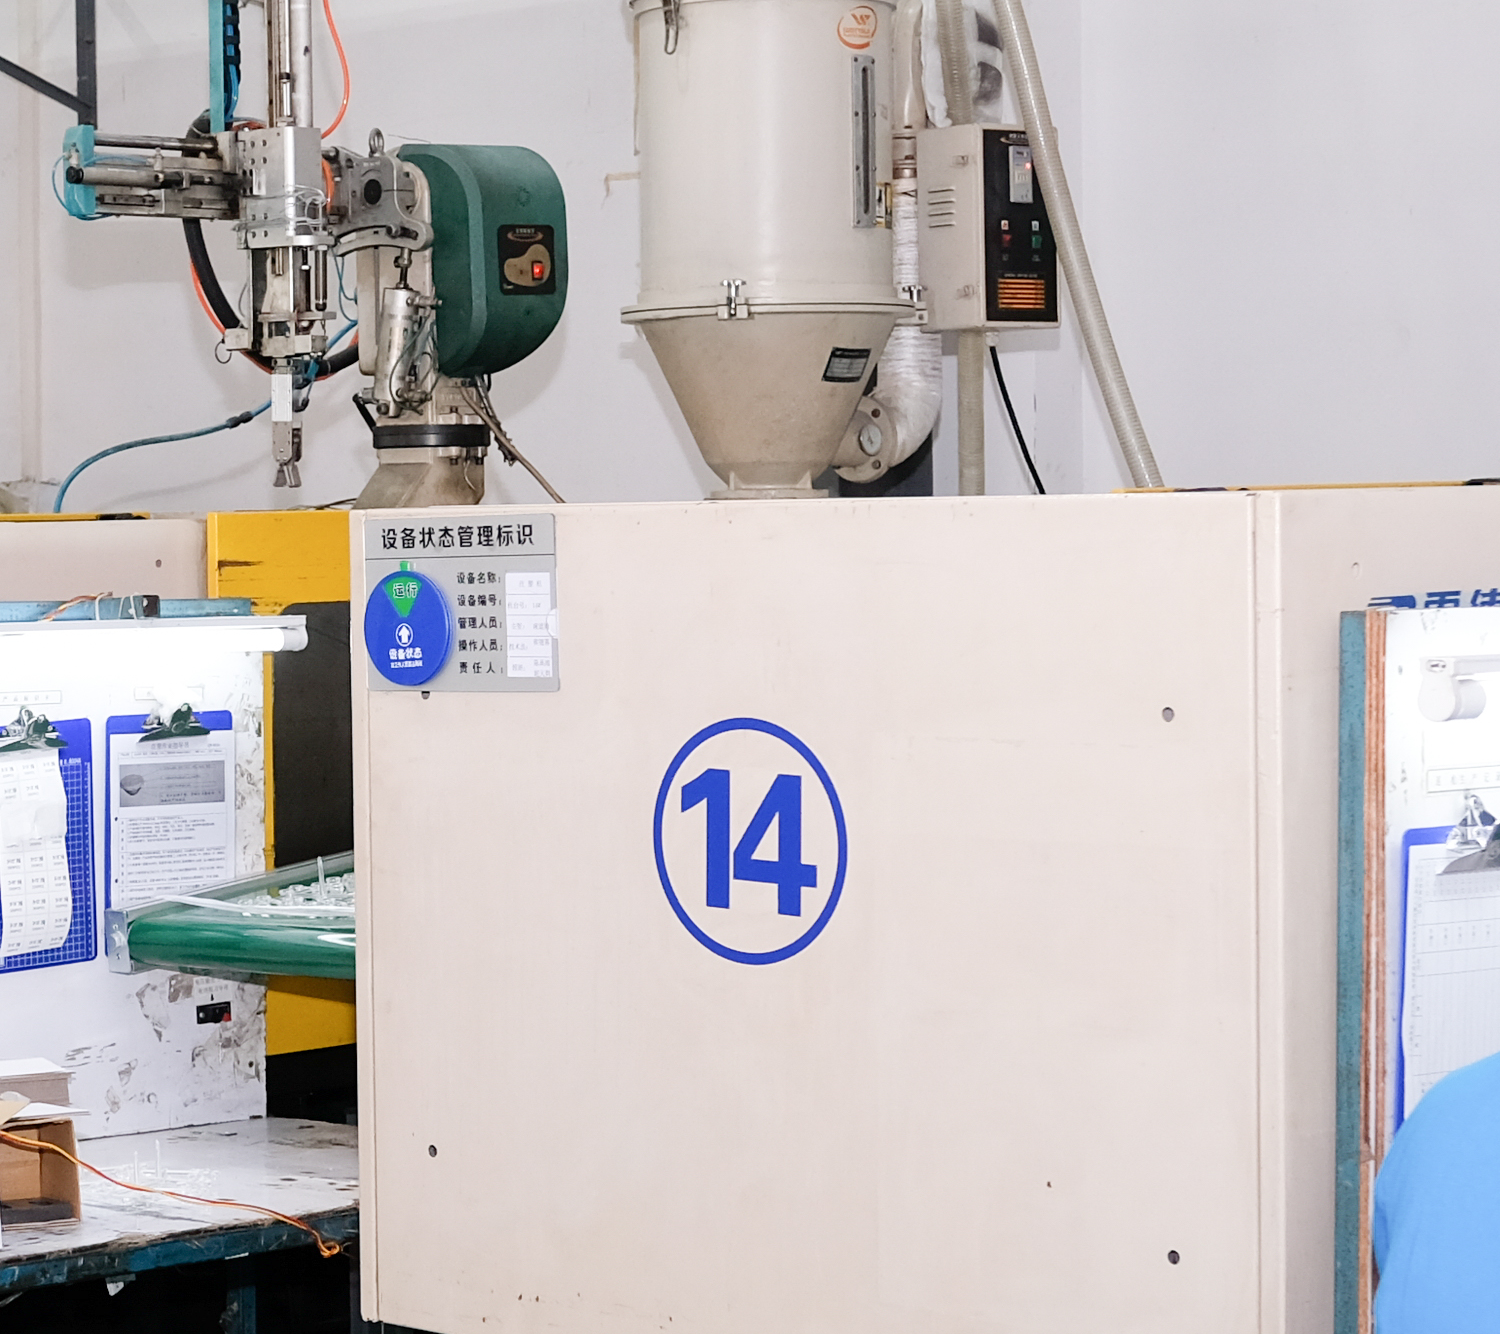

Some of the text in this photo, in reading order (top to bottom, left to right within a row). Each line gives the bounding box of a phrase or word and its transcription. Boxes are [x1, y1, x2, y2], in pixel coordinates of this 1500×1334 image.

[380, 523, 535, 550] 设备状态管理标识
[392, 581, 419, 599] 运行
[679, 767, 818, 918] 14
